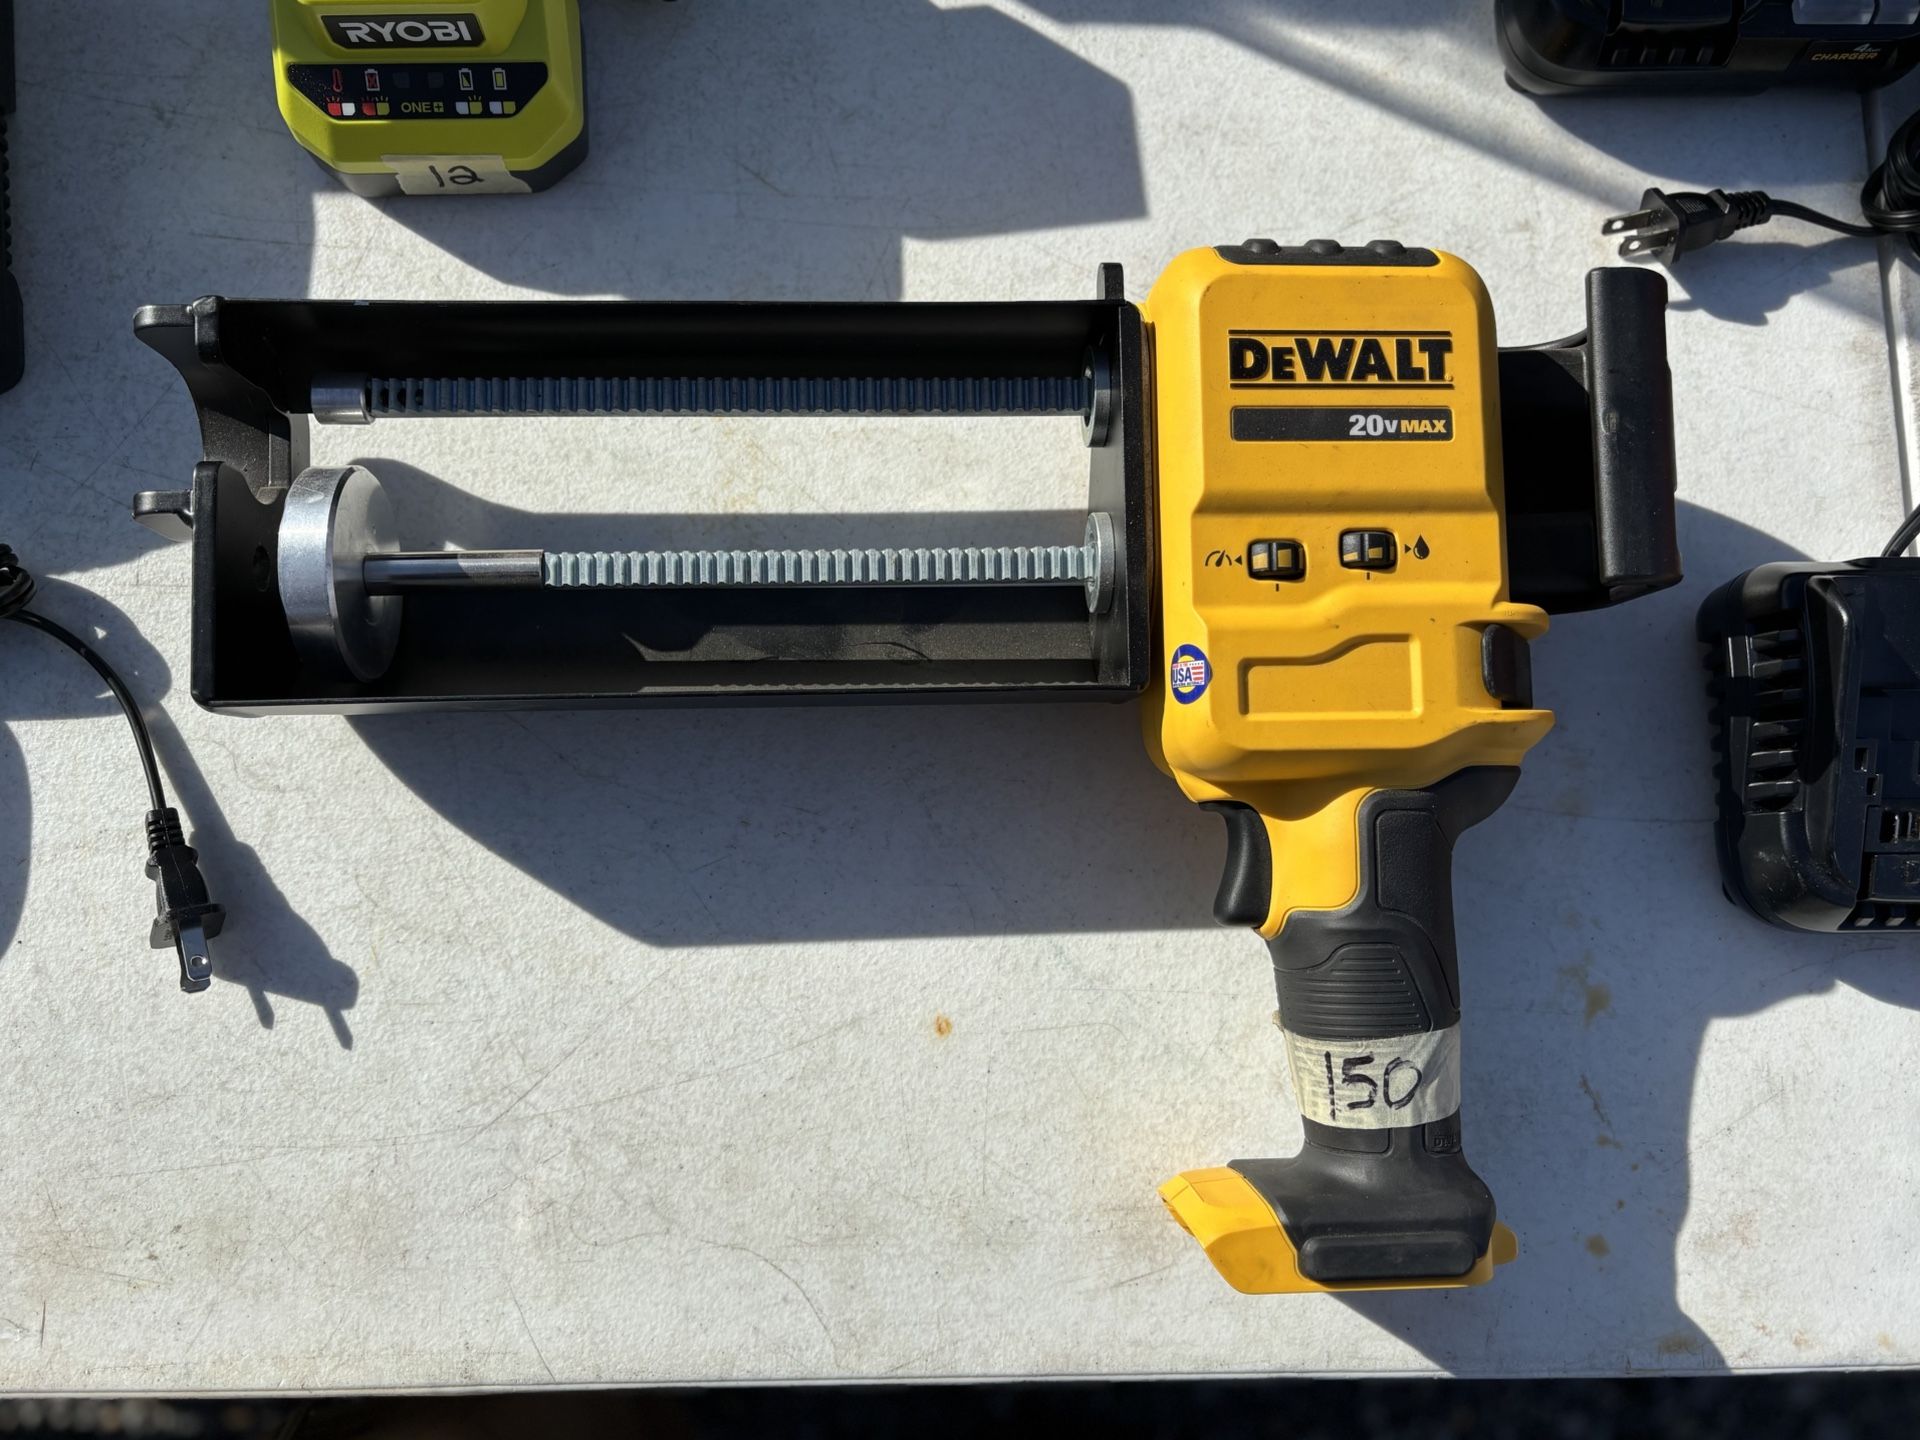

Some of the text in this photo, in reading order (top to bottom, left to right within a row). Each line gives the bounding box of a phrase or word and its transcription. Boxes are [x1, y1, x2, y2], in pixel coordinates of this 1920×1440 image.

[338, 20, 473, 44] RYOBI
[1811, 52, 1878, 61] CHARGER
[428, 164, 485, 188] 12
[1400, 419, 1447, 433] MAX
[1172, 666, 1193, 683] USA
[1323, 1050, 1423, 1120] 150
